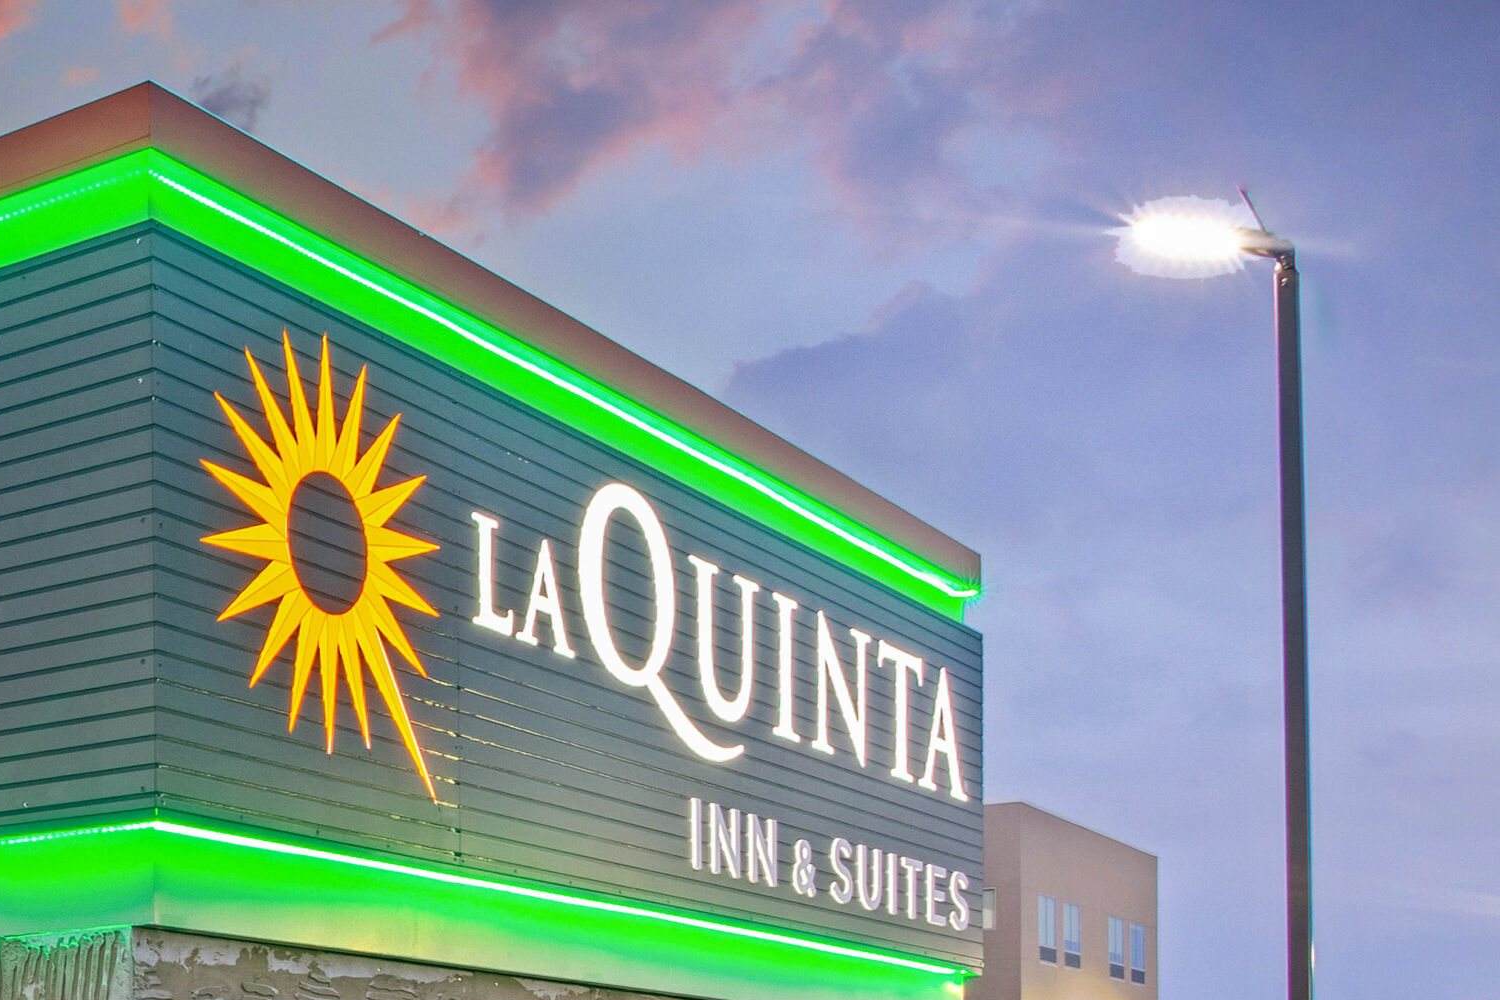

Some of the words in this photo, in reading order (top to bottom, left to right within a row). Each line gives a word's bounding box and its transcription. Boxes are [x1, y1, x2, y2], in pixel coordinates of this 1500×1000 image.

[689, 796, 778, 889] INN
[792, 838, 817, 898] &
[829, 837, 970, 932] SUITES
